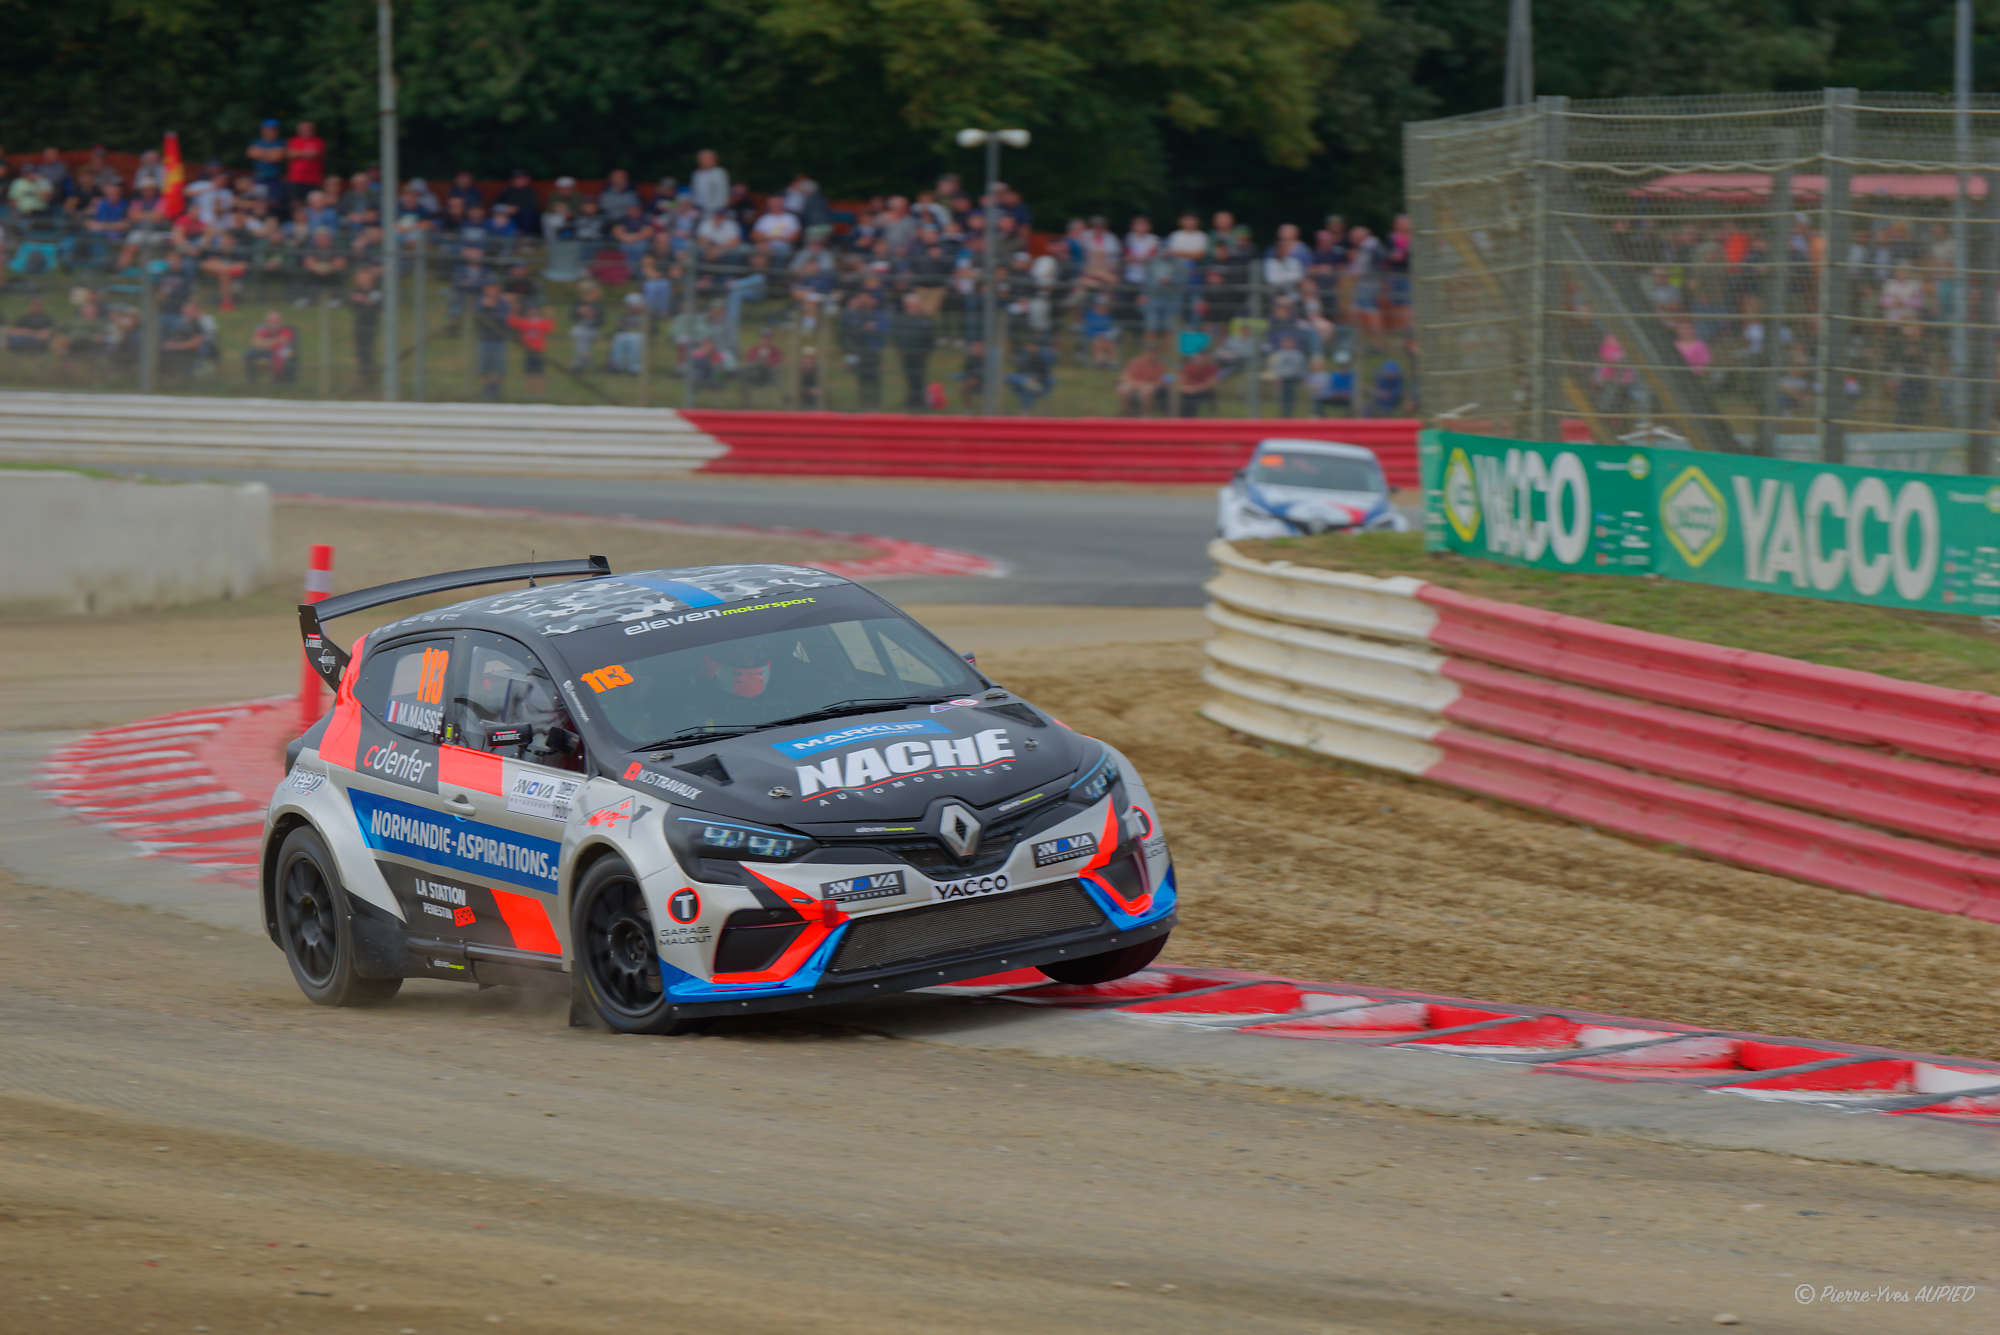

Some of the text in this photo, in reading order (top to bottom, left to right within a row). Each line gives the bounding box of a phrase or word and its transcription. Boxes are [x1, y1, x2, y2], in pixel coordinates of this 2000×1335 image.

[1731, 472, 1940, 600] YACCO
[624, 597, 816, 635] eleven motorsport
[416, 648, 449, 705] 113
[580, 665, 634, 693] 113
[792, 723, 924, 749] MARKUP
[796, 729, 1015, 796] NACHE
[820, 764, 1013, 807] AUTOMOBILES
[415, 878, 467, 906] LA STATION
[934, 875, 1008, 900] YACCO
[674, 893, 695, 919] T
[660, 926, 711, 937] GARAGE
